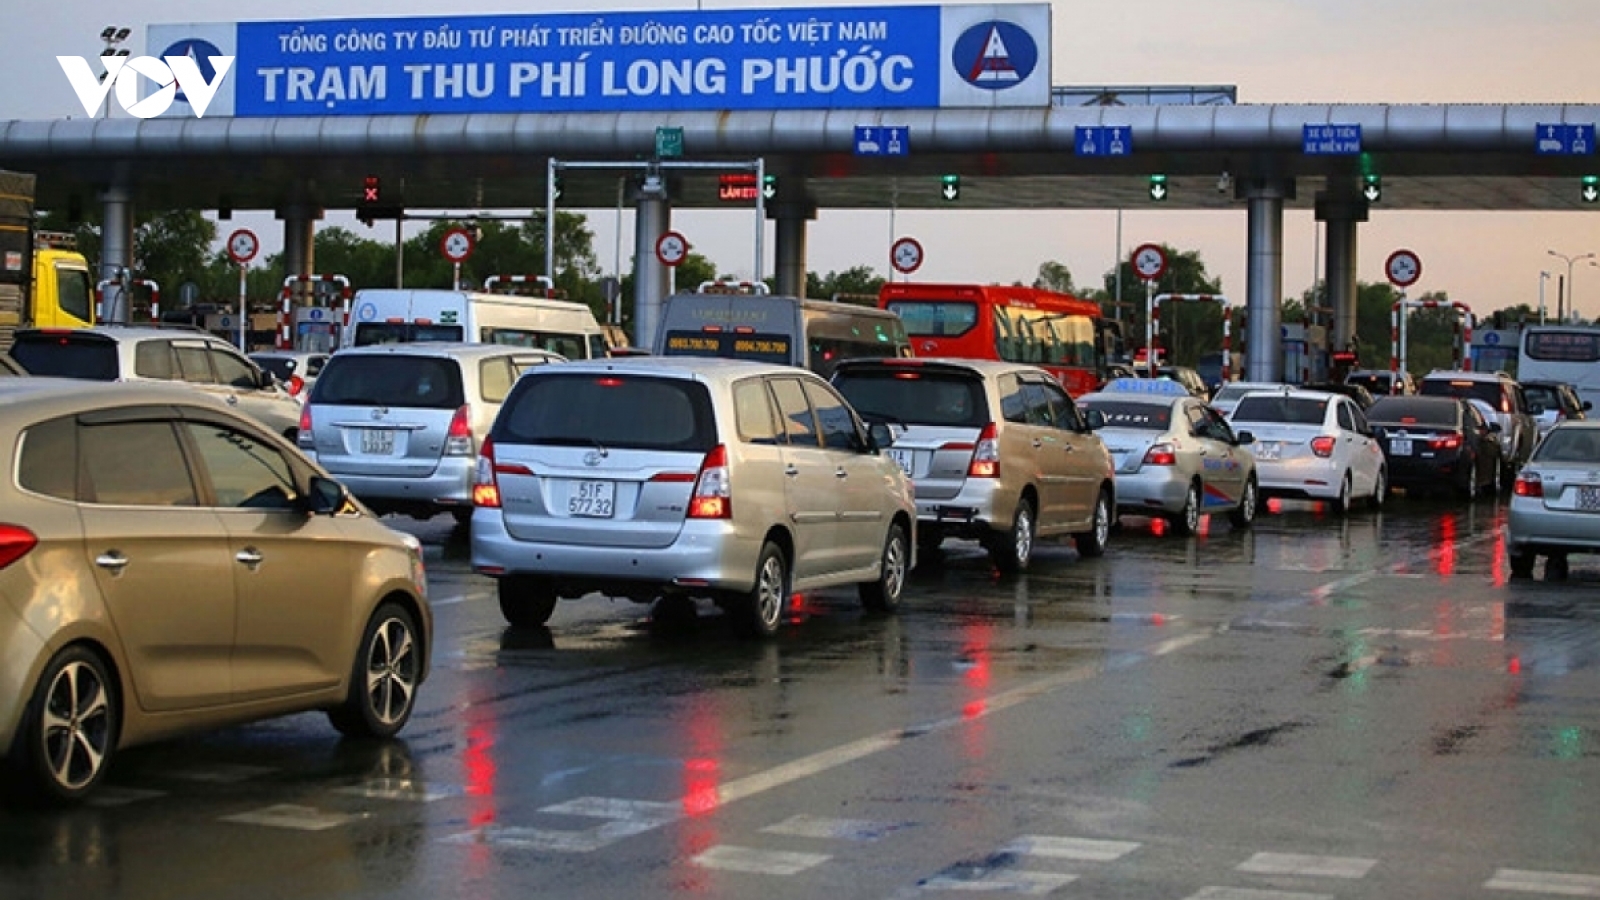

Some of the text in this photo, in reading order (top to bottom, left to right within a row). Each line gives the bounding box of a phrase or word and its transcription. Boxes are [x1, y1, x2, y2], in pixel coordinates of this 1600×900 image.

[278, 26, 327, 52] TỔNG
[334, 28, 386, 51] CÔNG
[393, 32, 417, 50] TY
[468, 26, 496, 47] TƯ
[501, 24, 551, 46] PHÁT
[557, 18, 613, 45] TRIỂN
[620, 20, 687, 44] ĐƯỜNG
[693, 24, 734, 43] CAO
[741, 18, 782, 42] TỐC
[787, 18, 832, 45] VIỆT
[839, 21, 887, 40] NAM
[258, 45, 914, 108] TRẠM THU PHÍ LONG PHƯỚC
[578, 483, 604, 498] 51F
